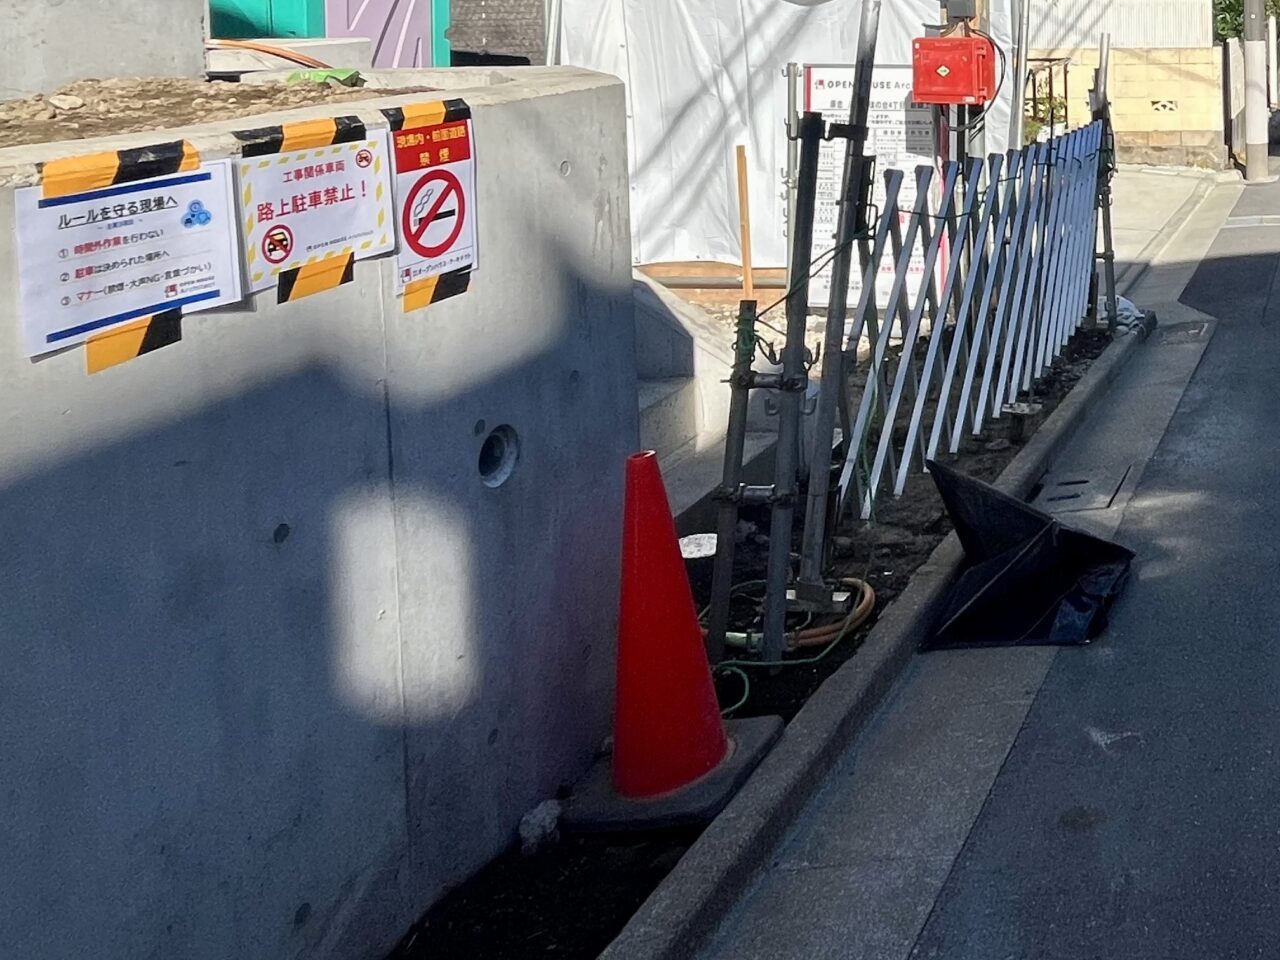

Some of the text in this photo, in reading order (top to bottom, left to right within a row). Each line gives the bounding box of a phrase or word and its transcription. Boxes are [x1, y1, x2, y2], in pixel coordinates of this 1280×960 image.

[282, 160, 345, 183] 工事関係車両
[58, 195, 178, 227] ルールを守る現場へ
